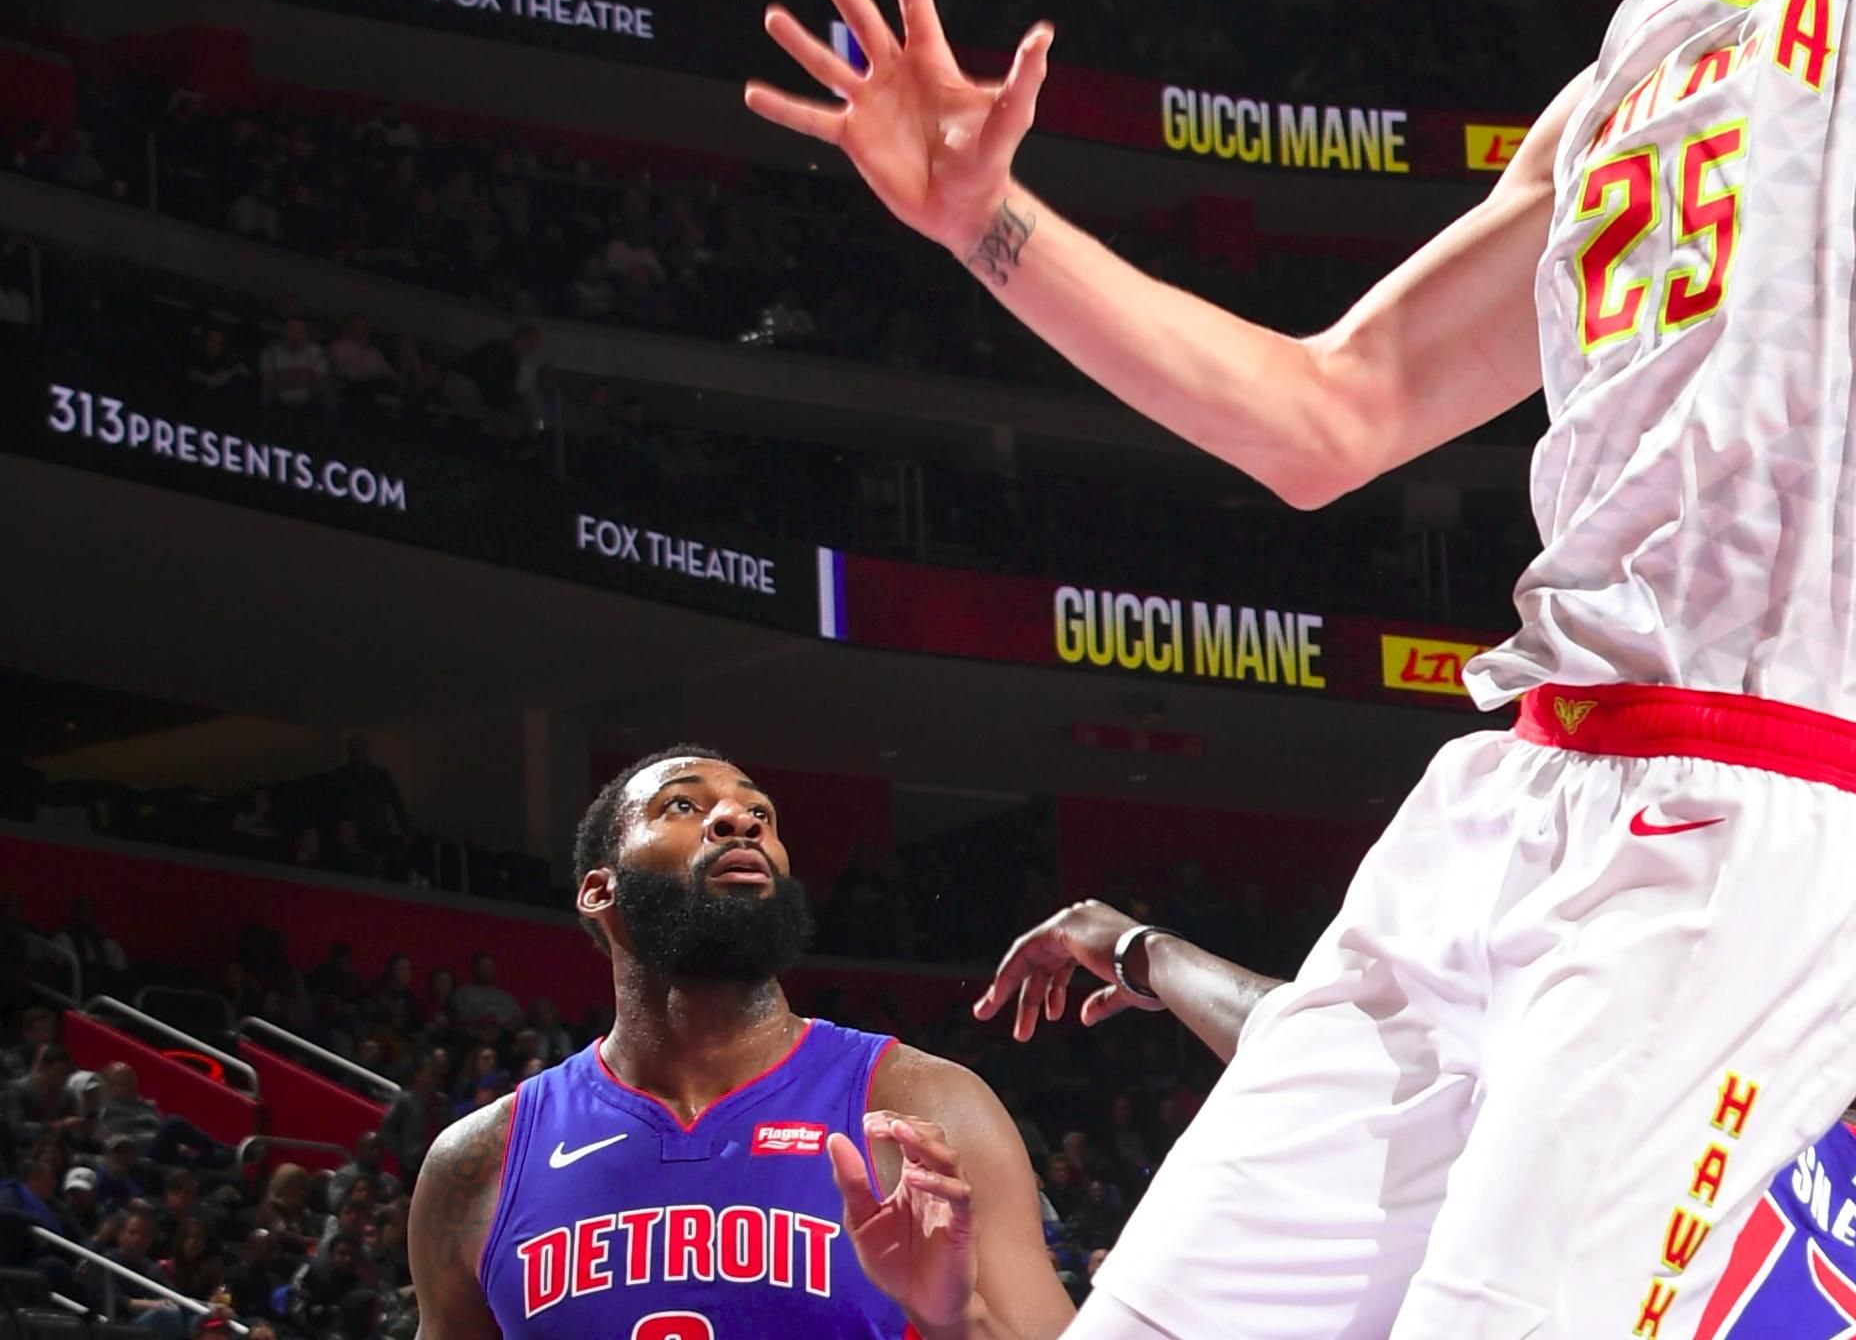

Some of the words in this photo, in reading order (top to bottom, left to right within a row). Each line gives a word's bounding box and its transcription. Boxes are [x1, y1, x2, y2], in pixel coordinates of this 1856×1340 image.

[1161, 85, 1272, 164] GUCCI
[1279, 103, 1409, 174] MANE
[1574, 116, 1749, 357] 25
[48, 383, 407, 511] 313PRESENTS.COM
[578, 515, 641, 562] FOX
[646, 531, 777, 594] THEATRE
[1053, 585, 1183, 674] GUCCI
[1192, 600, 1327, 689] MANE
[758, 1126, 823, 1141] Flagstar
[517, 1203, 842, 1320] DETROIT
